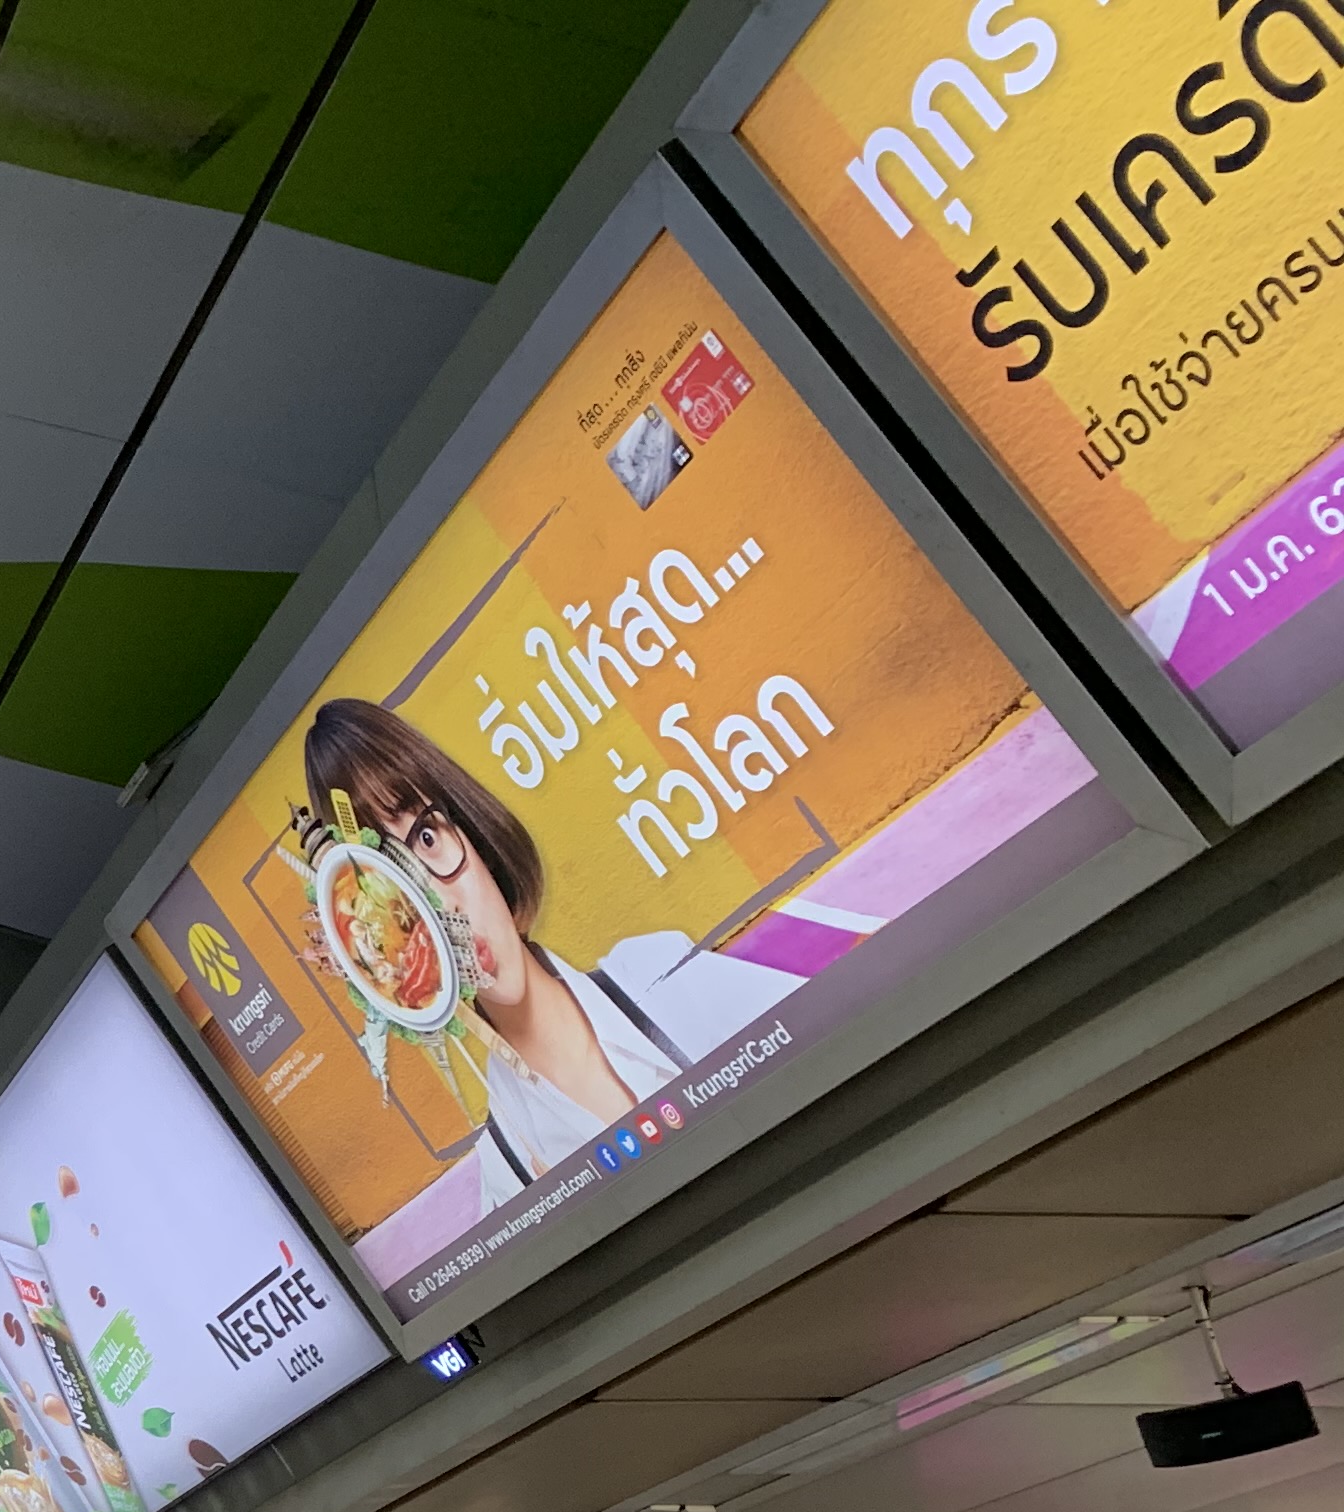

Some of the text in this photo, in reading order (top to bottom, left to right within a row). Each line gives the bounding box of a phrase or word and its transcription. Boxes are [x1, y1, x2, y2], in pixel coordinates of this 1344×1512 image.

[1230, 534, 1315, 600] ม.ค.
[614, 672, 836, 879] ทั่วโลก
[228, 983, 273, 1037] krungsri
[246, 1012, 285, 1055] Credit Cards
[682, 1020, 794, 1109] KrungsriCard
[407, 1166, 596, 1304] Call 0 2646 3939 www.krungsricard.com
[277, 1342, 325, 1384] Latte
